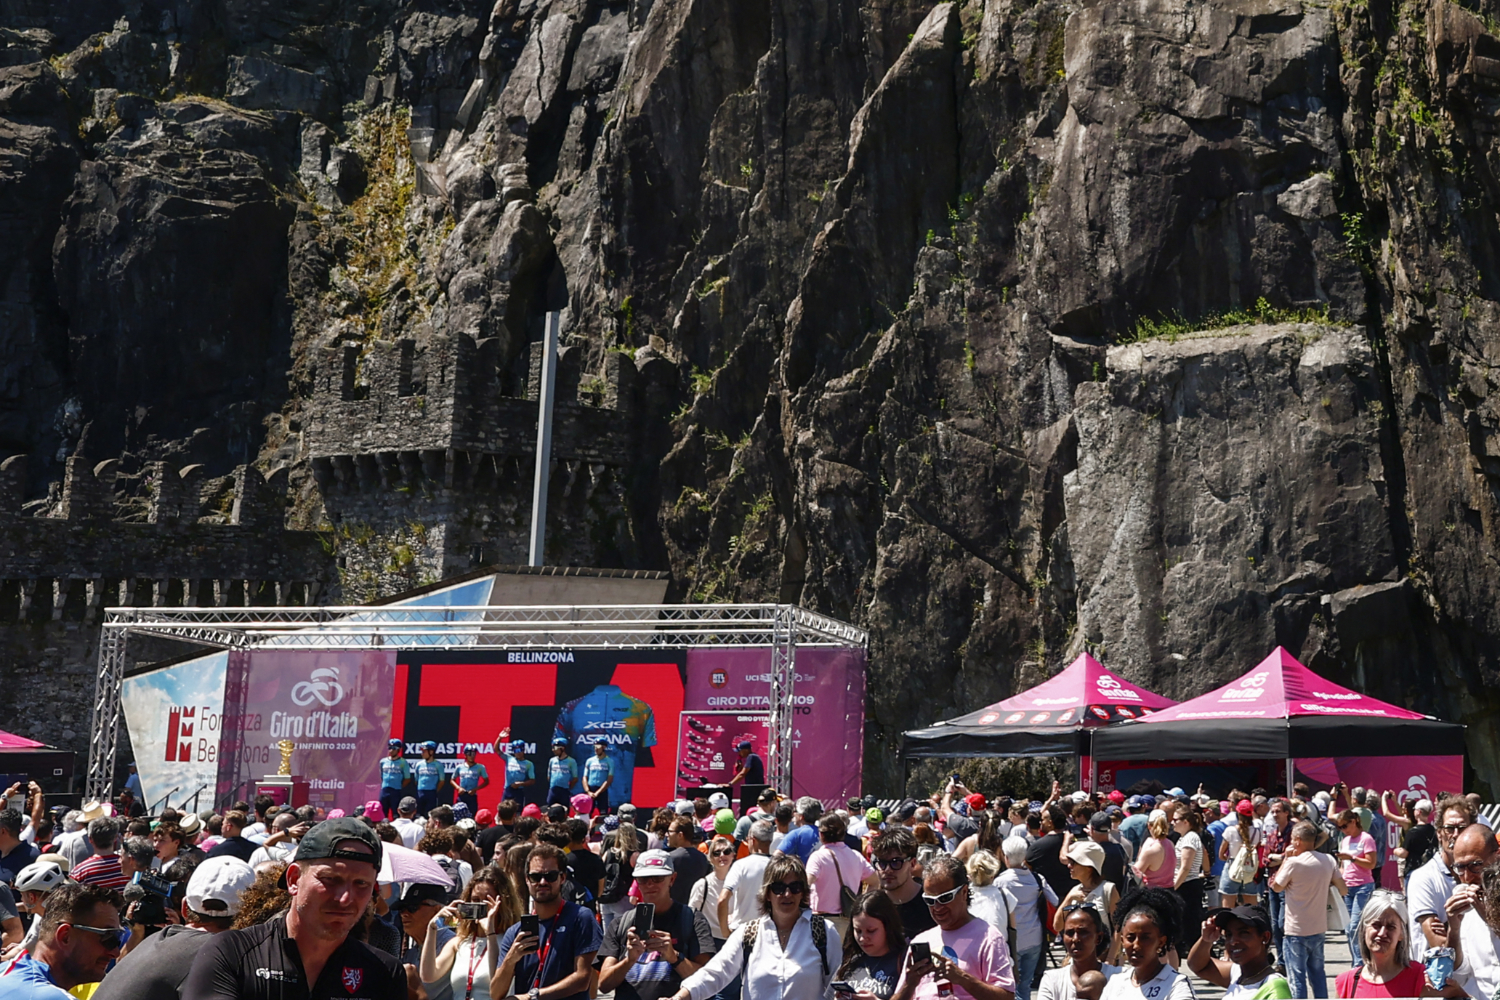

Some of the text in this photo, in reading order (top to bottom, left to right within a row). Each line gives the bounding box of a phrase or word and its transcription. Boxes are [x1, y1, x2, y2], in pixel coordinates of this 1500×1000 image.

[508, 652, 574, 663] BELLINZONA
[707, 696, 737, 705] GIRO
[270, 711, 358, 738] Giro d'Italia
[1146, 986, 1161, 997] 13
